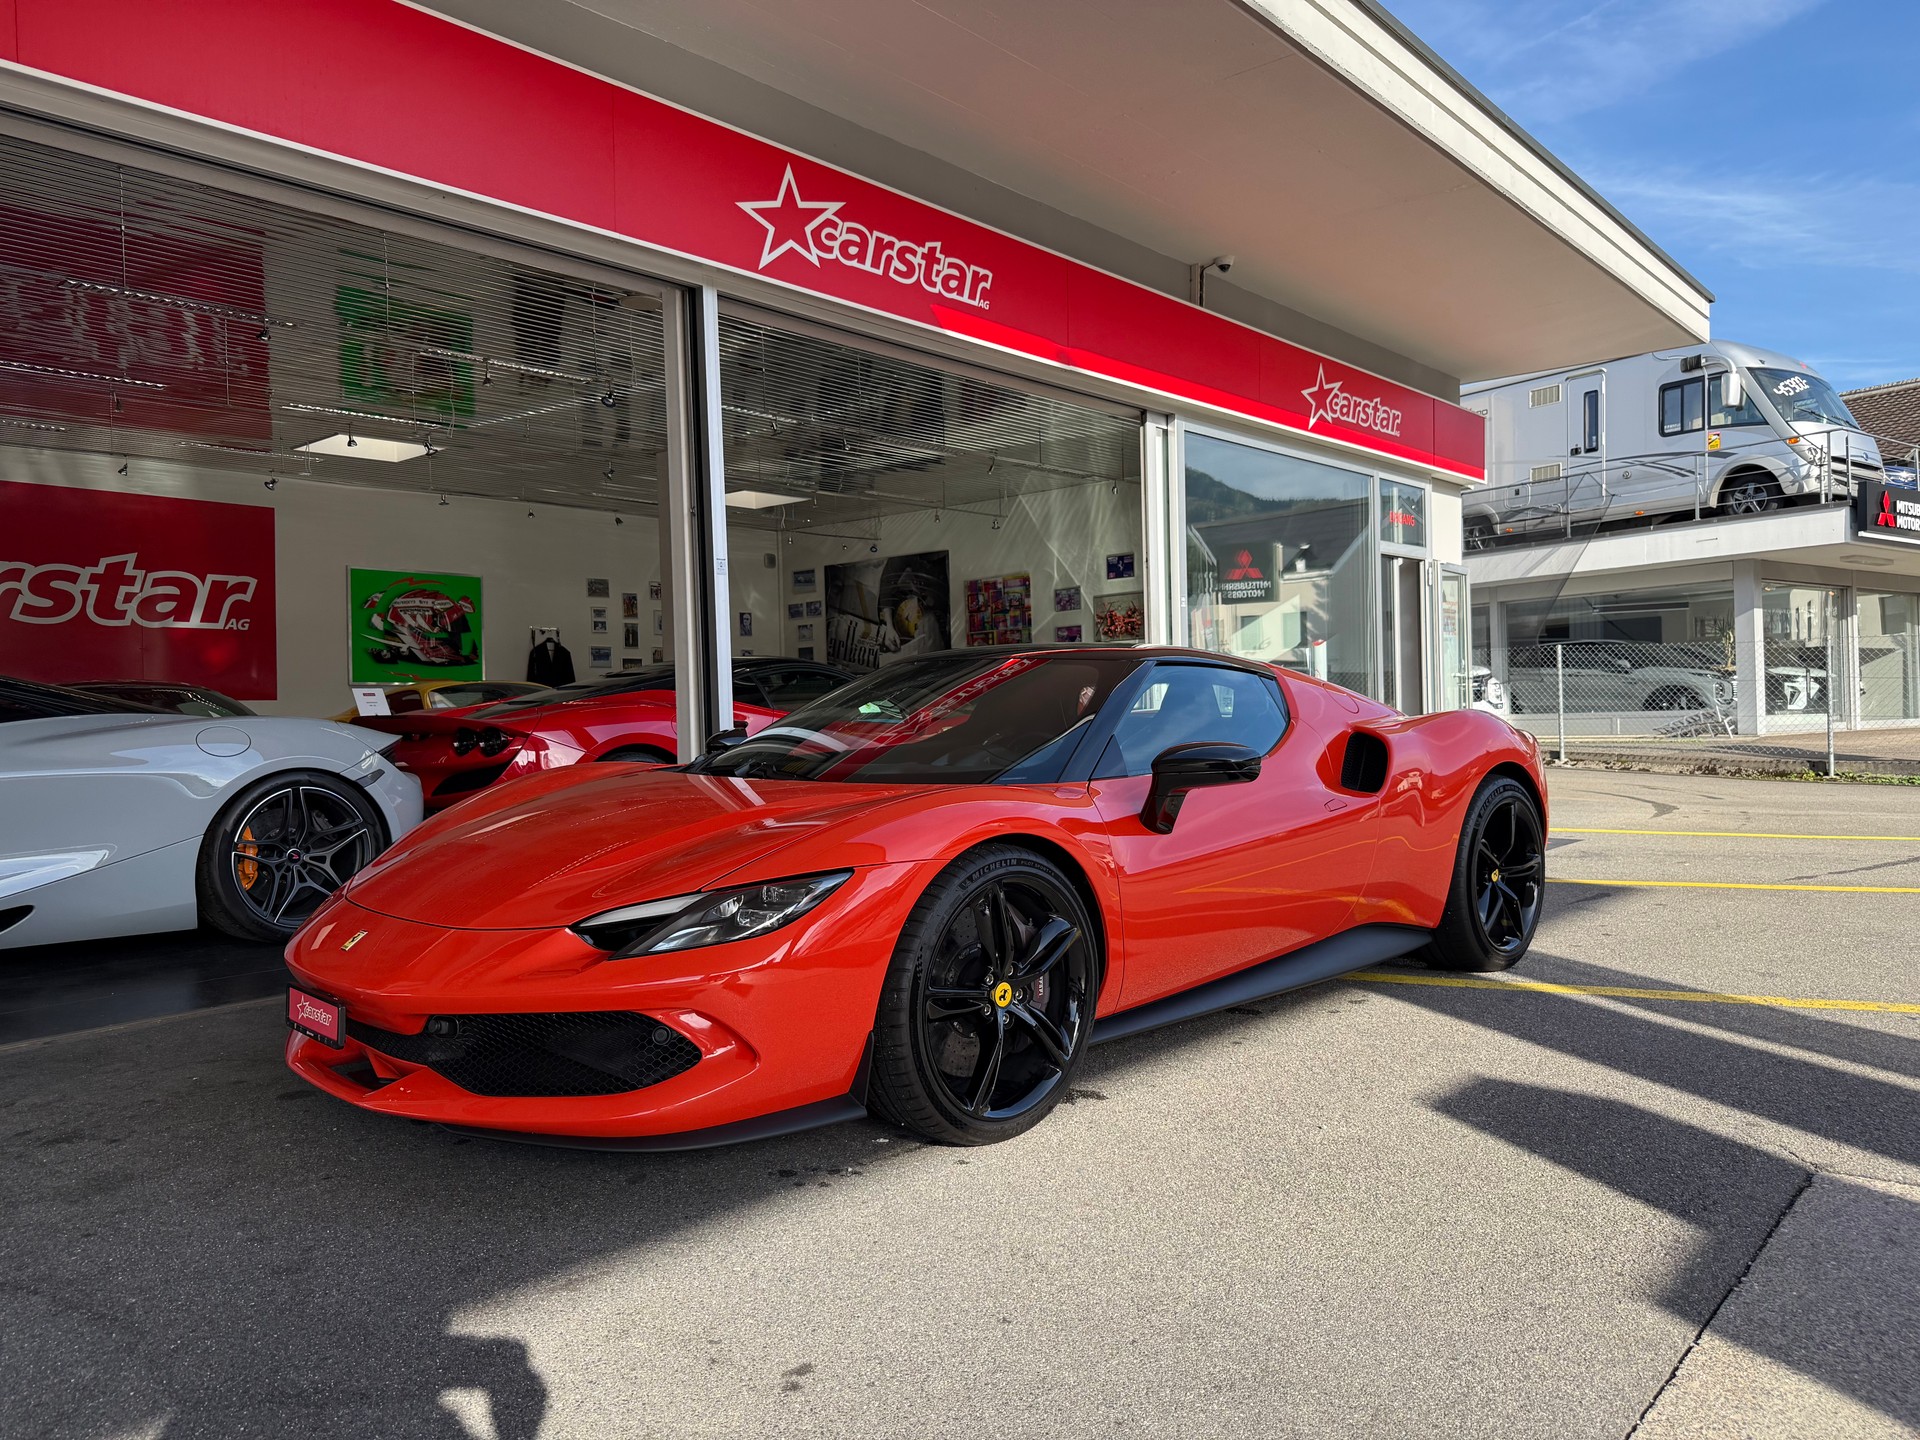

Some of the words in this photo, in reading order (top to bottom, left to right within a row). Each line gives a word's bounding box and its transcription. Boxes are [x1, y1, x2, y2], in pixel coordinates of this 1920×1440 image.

[811, 214, 993, 306] carstar
[978, 300, 990, 310] AG
[1329, 391, 1401, 435] carstar
[225, 618, 250, 631] AG
[971, 858, 1018, 882] MICHELIN
[305, 1006, 332, 1026] carstar
